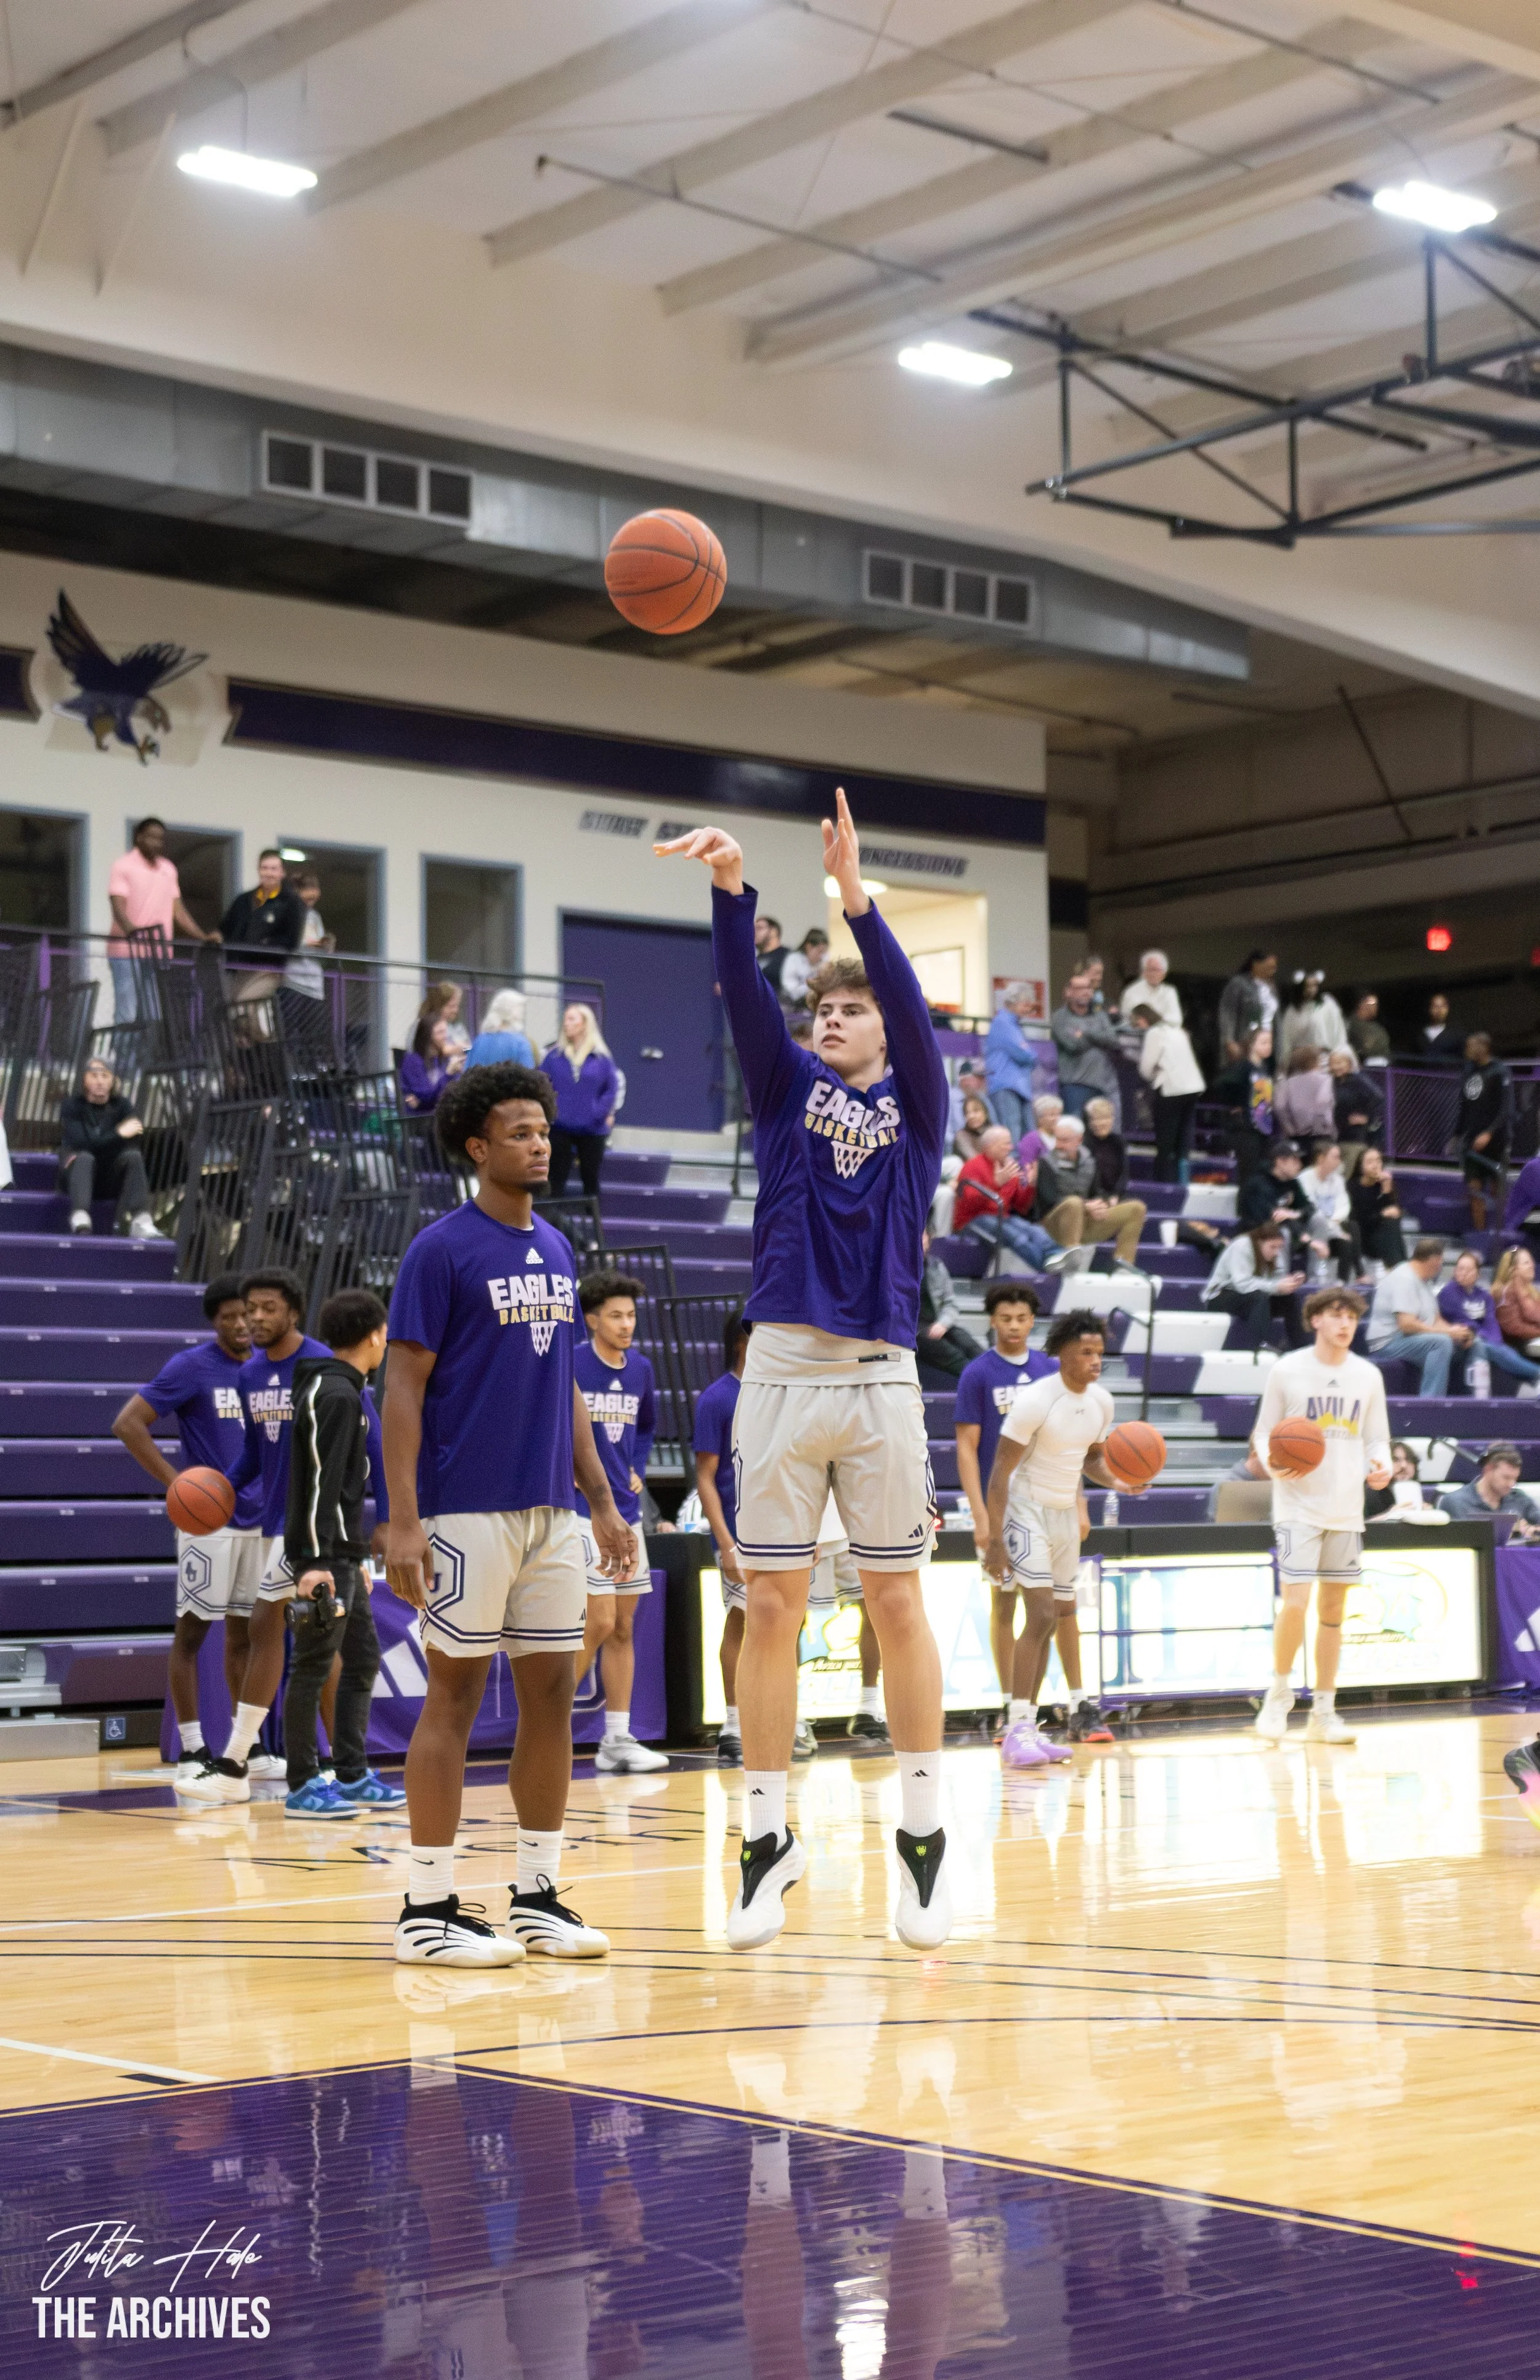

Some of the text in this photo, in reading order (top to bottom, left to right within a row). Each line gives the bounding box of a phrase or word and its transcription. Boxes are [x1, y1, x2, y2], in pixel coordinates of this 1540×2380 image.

[487, 1274, 573, 1310] EAGLES
[500, 1304, 574, 1326] BASKETBALL
[249, 1389, 294, 1413] EAGLE
[583, 1393, 639, 1415] EAGLES
